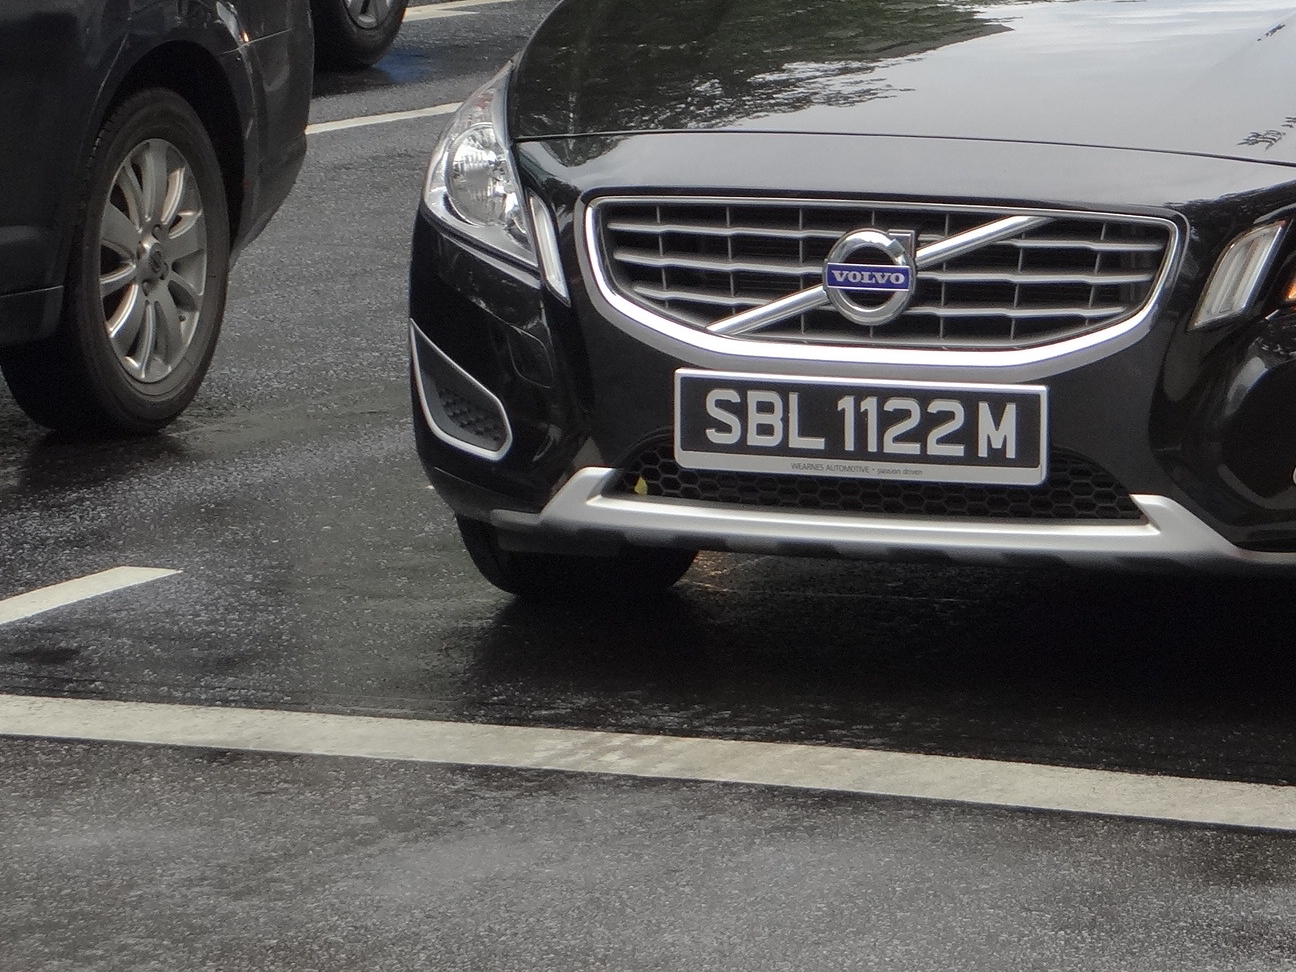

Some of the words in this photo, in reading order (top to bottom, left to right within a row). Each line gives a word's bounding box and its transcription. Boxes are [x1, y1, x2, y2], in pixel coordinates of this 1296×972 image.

[831, 270, 905, 284] VOLVO
[705, 388, 825, 450] SBL
[791, 462, 824, 472] WEARNES
[826, 464, 870, 474] AUTOMOTIVE
[877, 467, 901, 475] passion
